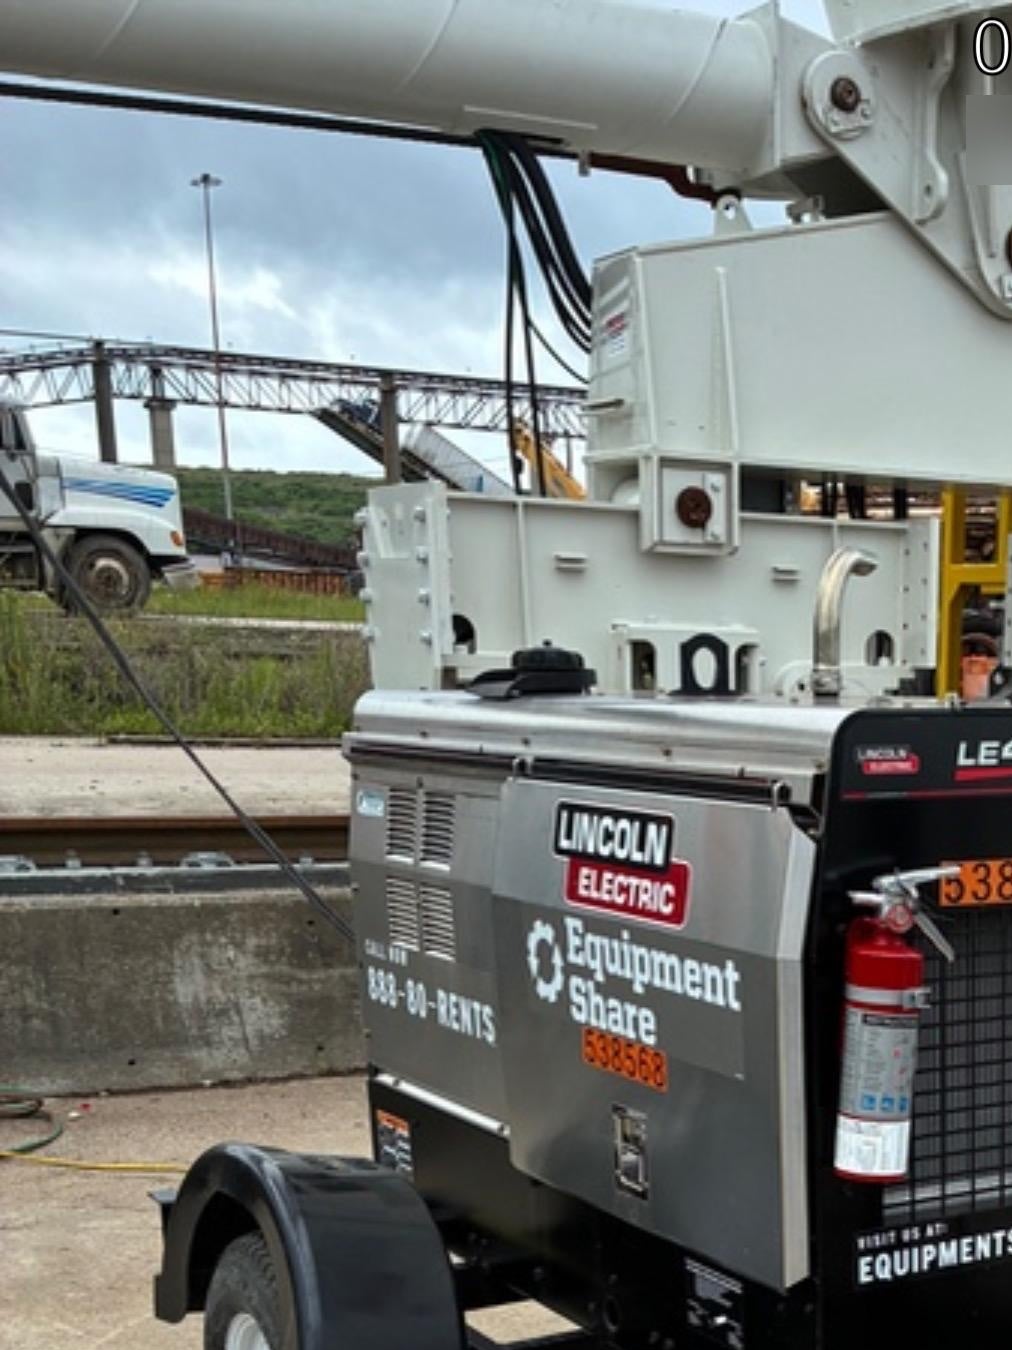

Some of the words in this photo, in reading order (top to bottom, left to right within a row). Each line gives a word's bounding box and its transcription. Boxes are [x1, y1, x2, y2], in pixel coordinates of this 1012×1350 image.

[557, 808, 668, 868] LINCOLN
[577, 866, 676, 915] ELECTRIC
[563, 916, 742, 1012] Equipment
[367, 965, 496, 1044] 888-80-RENTS
[569, 974, 658, 1045] Share
[585, 1028, 667, 1089] 538568
